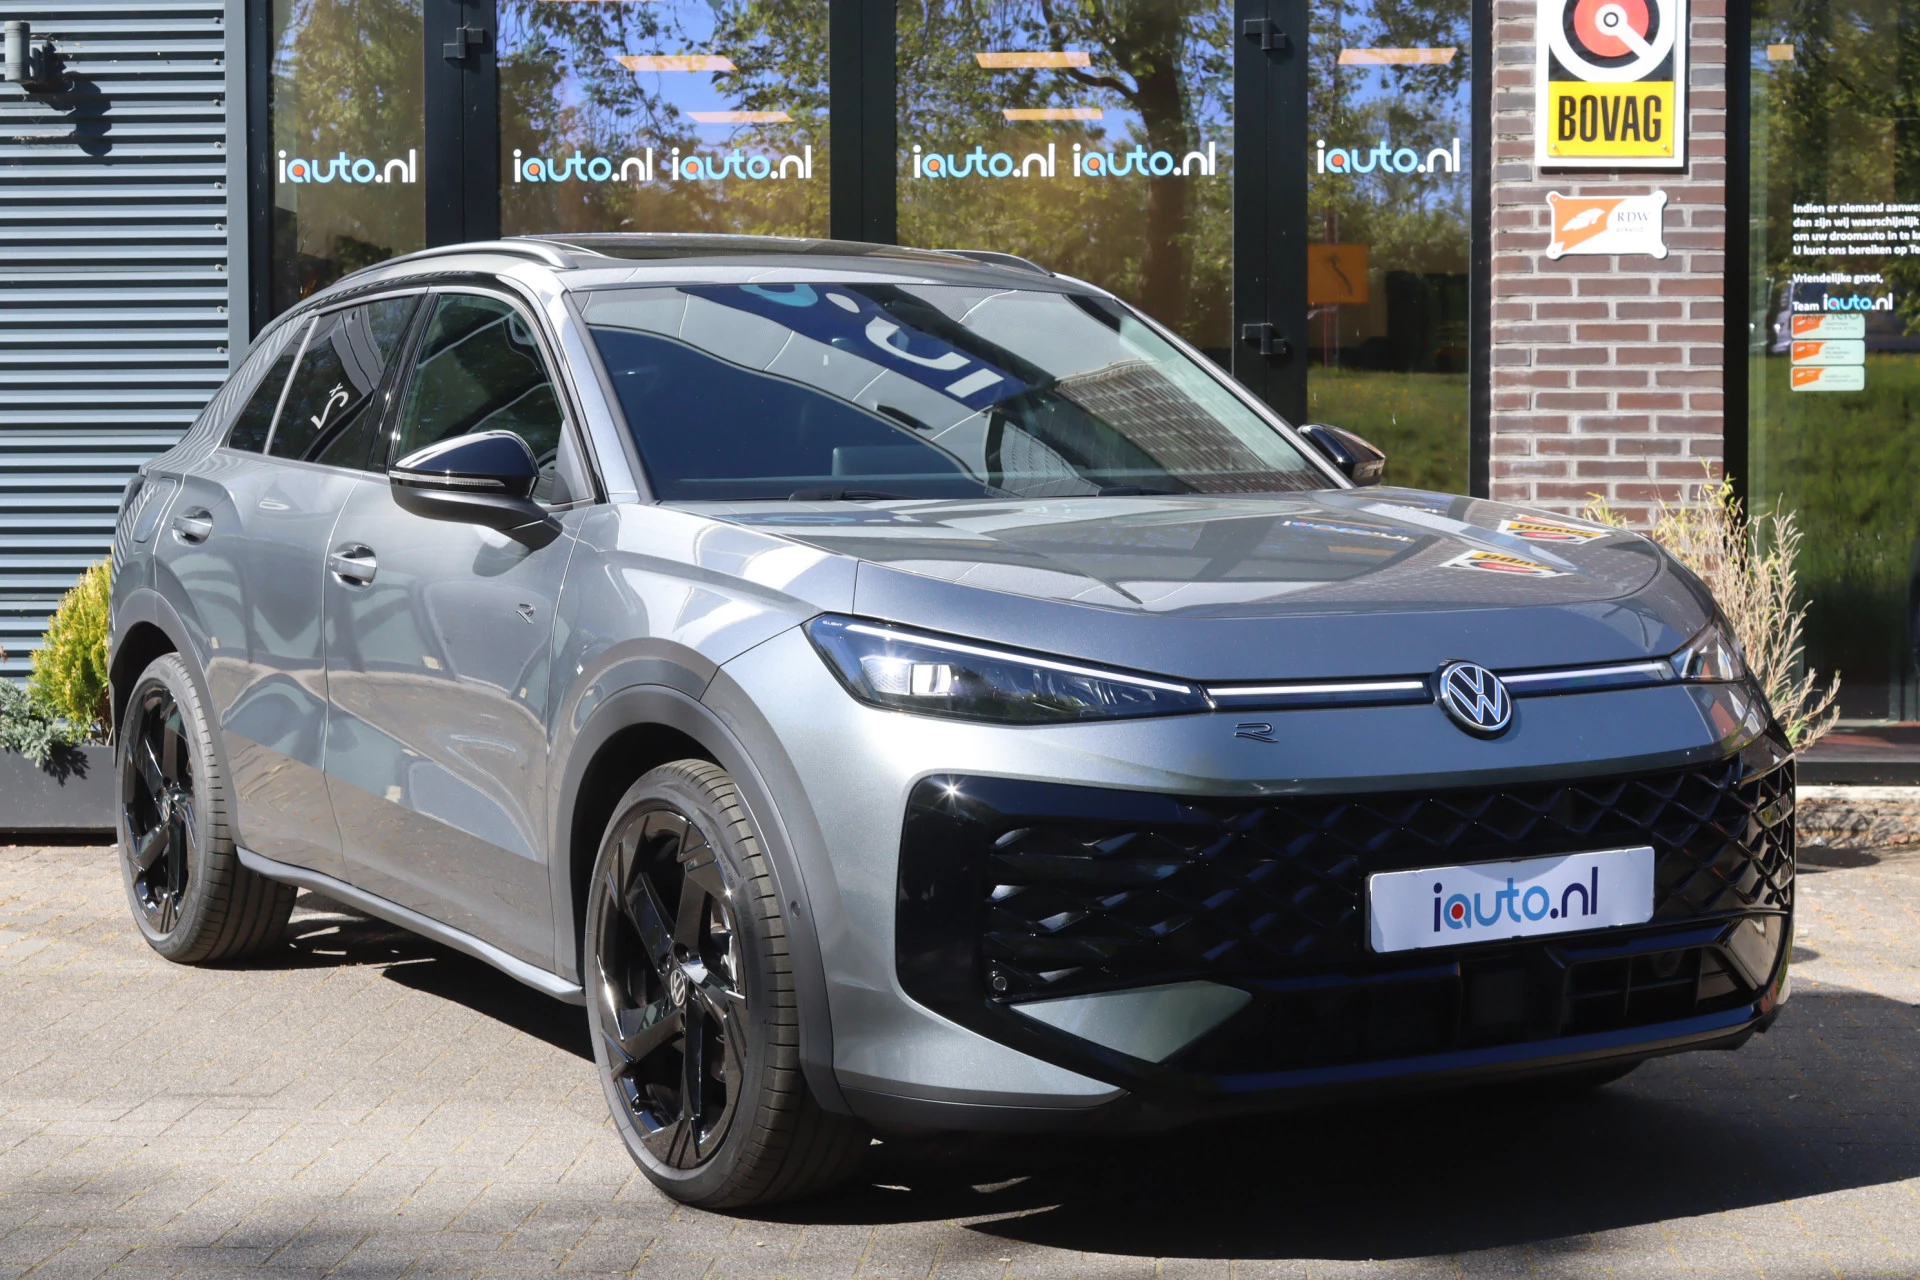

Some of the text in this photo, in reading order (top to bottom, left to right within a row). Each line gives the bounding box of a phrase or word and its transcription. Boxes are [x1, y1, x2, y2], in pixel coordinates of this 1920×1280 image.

[1557, 94, 1662, 142] BOVAG
[278, 148, 416, 184] iauto.nl
[513, 145, 813, 183] iauto.nl iauto.nl
[913, 141, 1216, 178] iauto.nl iauto.nl
[1316, 138, 1461, 175] iauto.nl
[1616, 211, 1651, 222] RDW
[1793, 203, 1825, 213] Indien
[1826, 204, 1838, 213] er
[1840, 202, 1884, 213] niemand
[1792, 216, 1920, 228] dan zijn wij waarschijnlijk
[1793, 233, 1809, 241] om
[1811, 233, 1828, 241] uw
[1829, 230, 1885, 241] droomauto
[1887, 230, 1897, 240] in
[1899, 231, 1910, 240] te
[1793, 246, 1801, 255] U
[1803, 245, 1826, 255] kunt
[1828, 246, 1846, 255] ons
[1848, 244, 1892, 255] bereiken
[1893, 246, 1907, 256] op
[1793, 272, 1883, 285] Vriendelijke groet,
[1793, 292, 1893, 311] Team iauto.nl
[1433, 866, 1598, 932] iauto.nl
